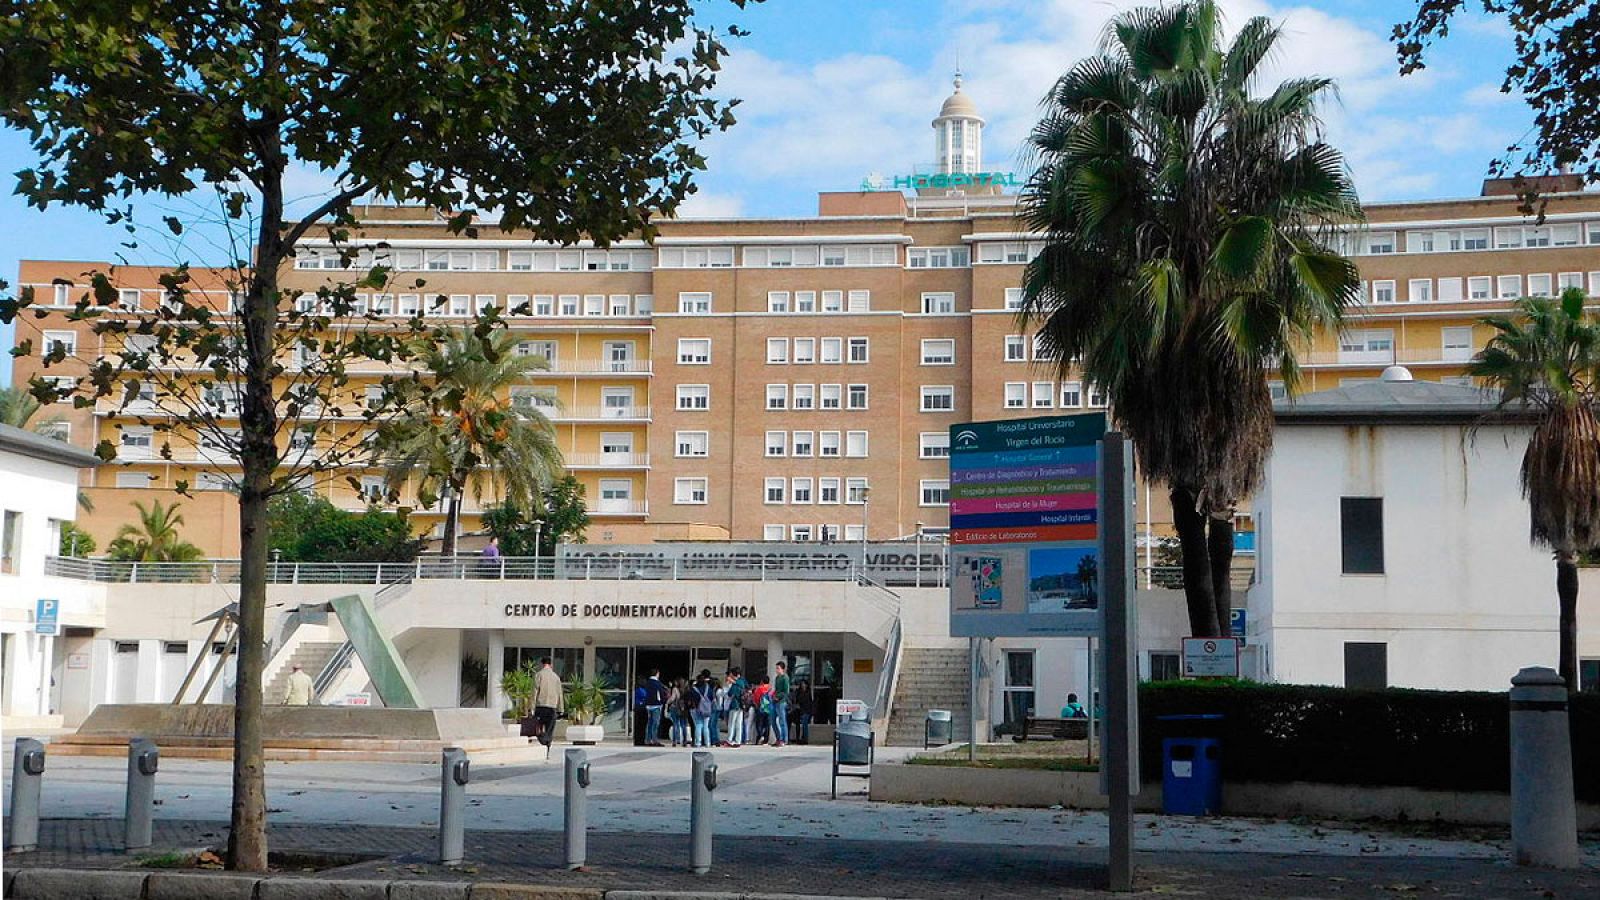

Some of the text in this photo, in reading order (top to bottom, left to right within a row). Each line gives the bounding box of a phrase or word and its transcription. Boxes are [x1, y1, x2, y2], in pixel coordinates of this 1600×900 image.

[894, 172, 1024, 188] HOSPITAL
[997, 419, 1075, 432] Hospital Universitario
[1006, 437, 1029, 447] Virgen
[1031, 436, 1042, 445] del
[1001, 453, 1053, 463] Hospital General
[966, 472, 986, 480] Centro
[988, 471, 997, 479] de
[1039, 467, 1077, 476] Tratamiento
[961, 487, 985, 496] Hospital
[995, 501, 1020, 510] Hospital
[1031, 500, 1038, 508] la
[1039, 499, 1057, 509] Mujer
[1040, 514, 1067, 523] Hospital
[966, 530, 1038, 541] Edificio de Laboratorios
[565, 552, 948, 571] HOSPITAL UNIVERSITARIO VIRGEN
[43, 601, 53, 615] P
[504, 602, 758, 619] CENTRO DE DOCUMENTACIÓN CLÍNICA
[1231, 611, 1241, 626] P
